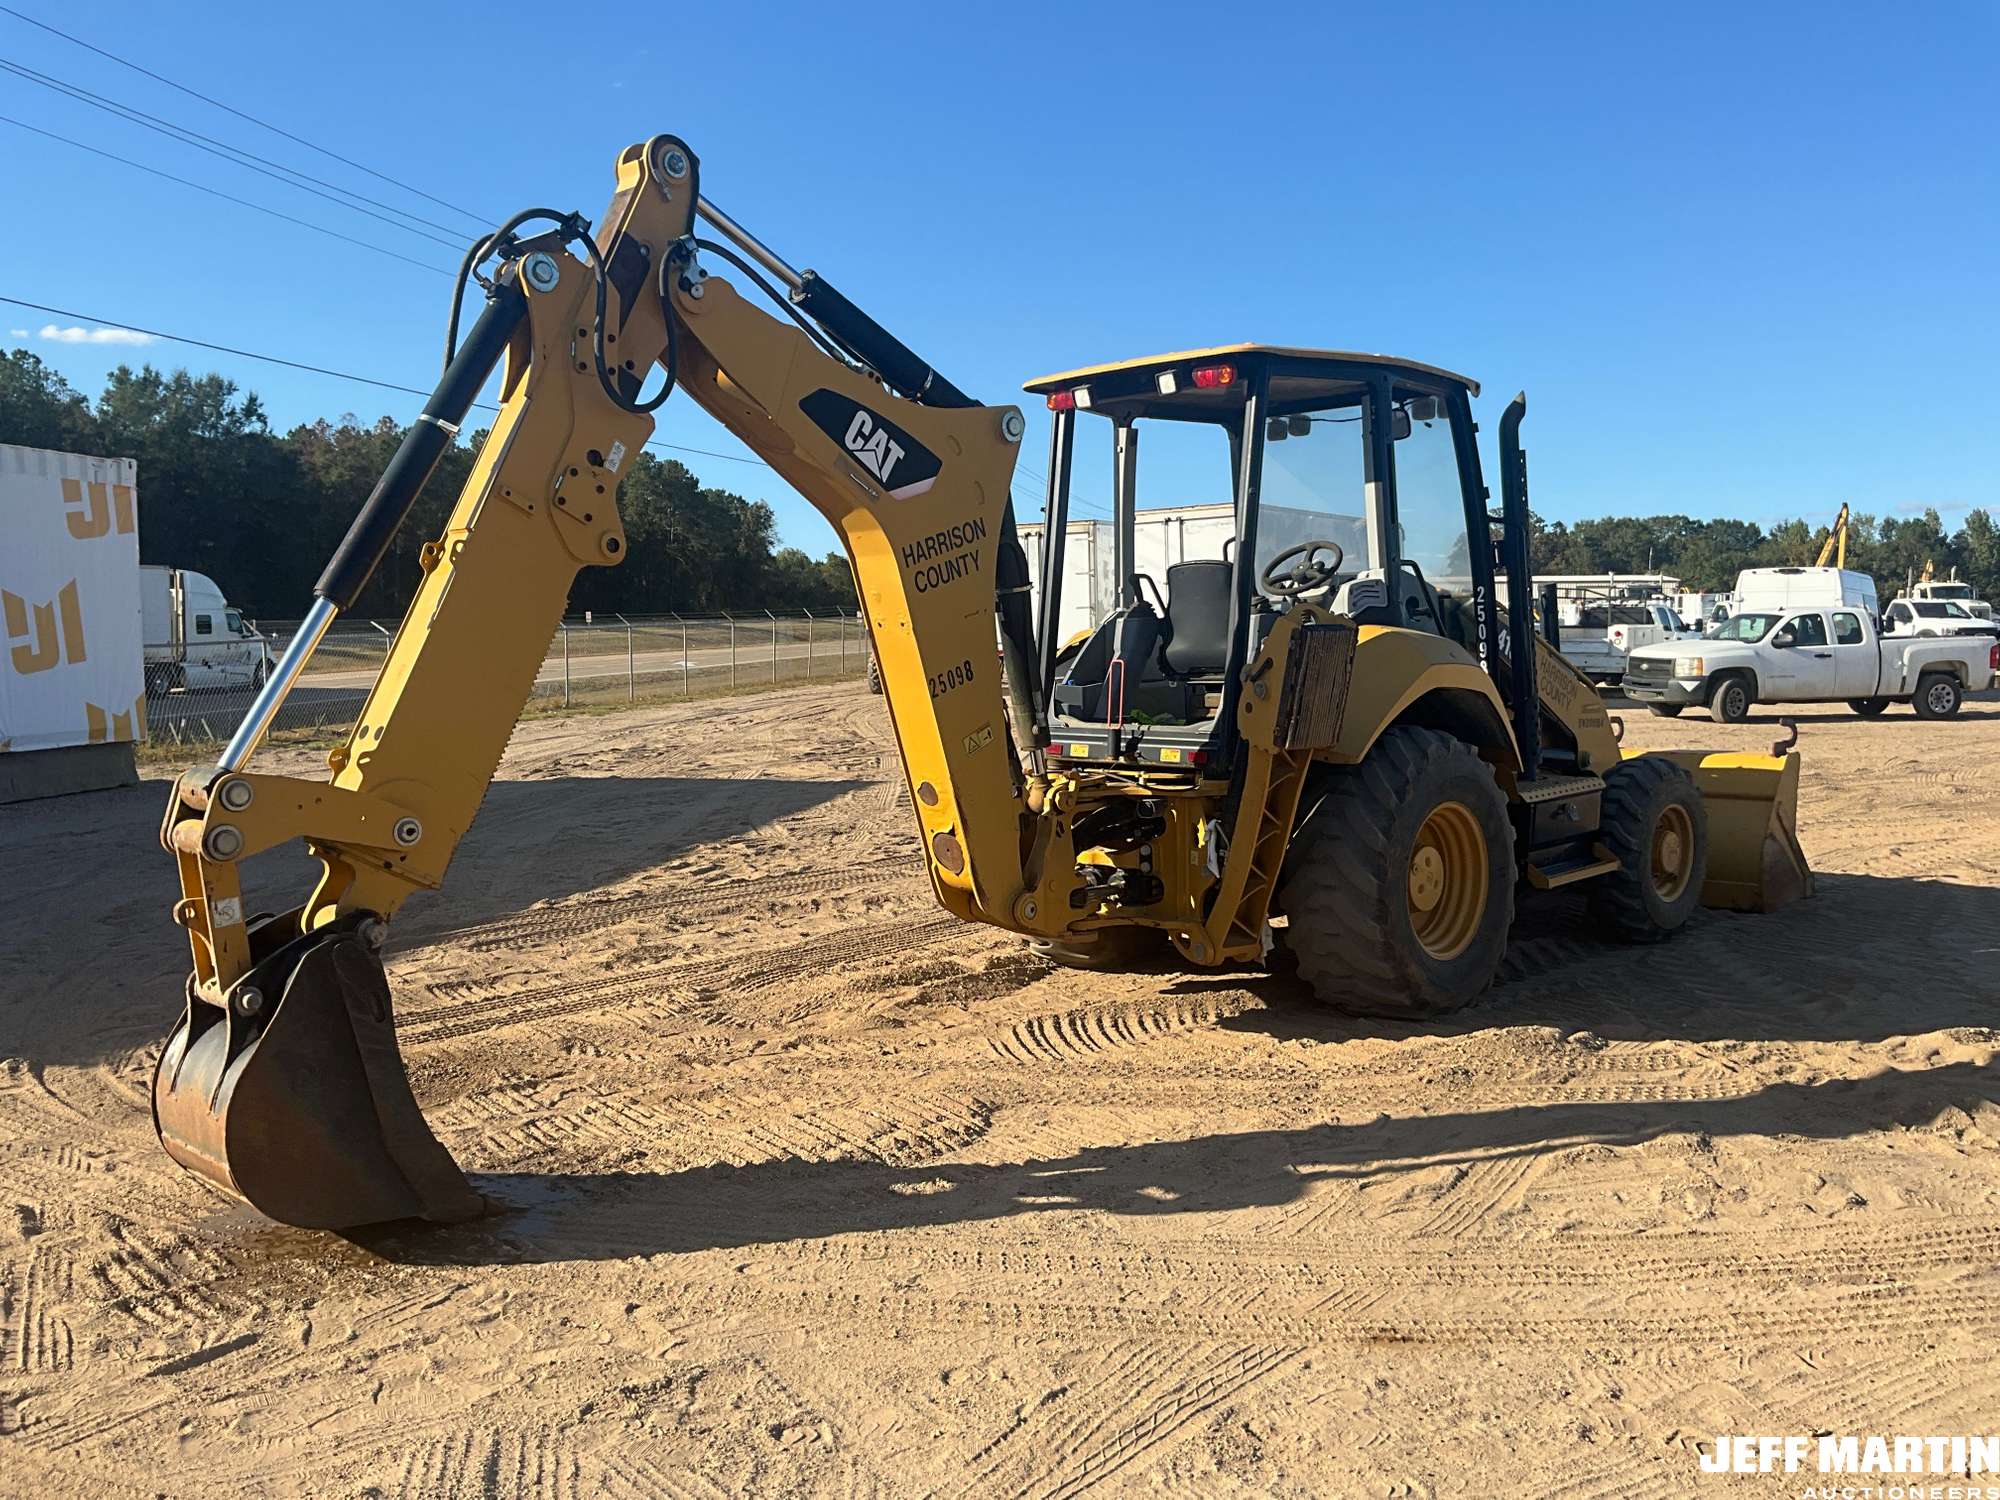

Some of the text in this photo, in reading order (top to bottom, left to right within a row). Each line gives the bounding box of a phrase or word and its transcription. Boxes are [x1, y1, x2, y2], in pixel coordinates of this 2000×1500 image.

[844, 410, 905, 483] CAT
[902, 517, 986, 568] HARRISON
[914, 550, 982, 593] COUNTY
[929, 660, 974, 699] 25098
